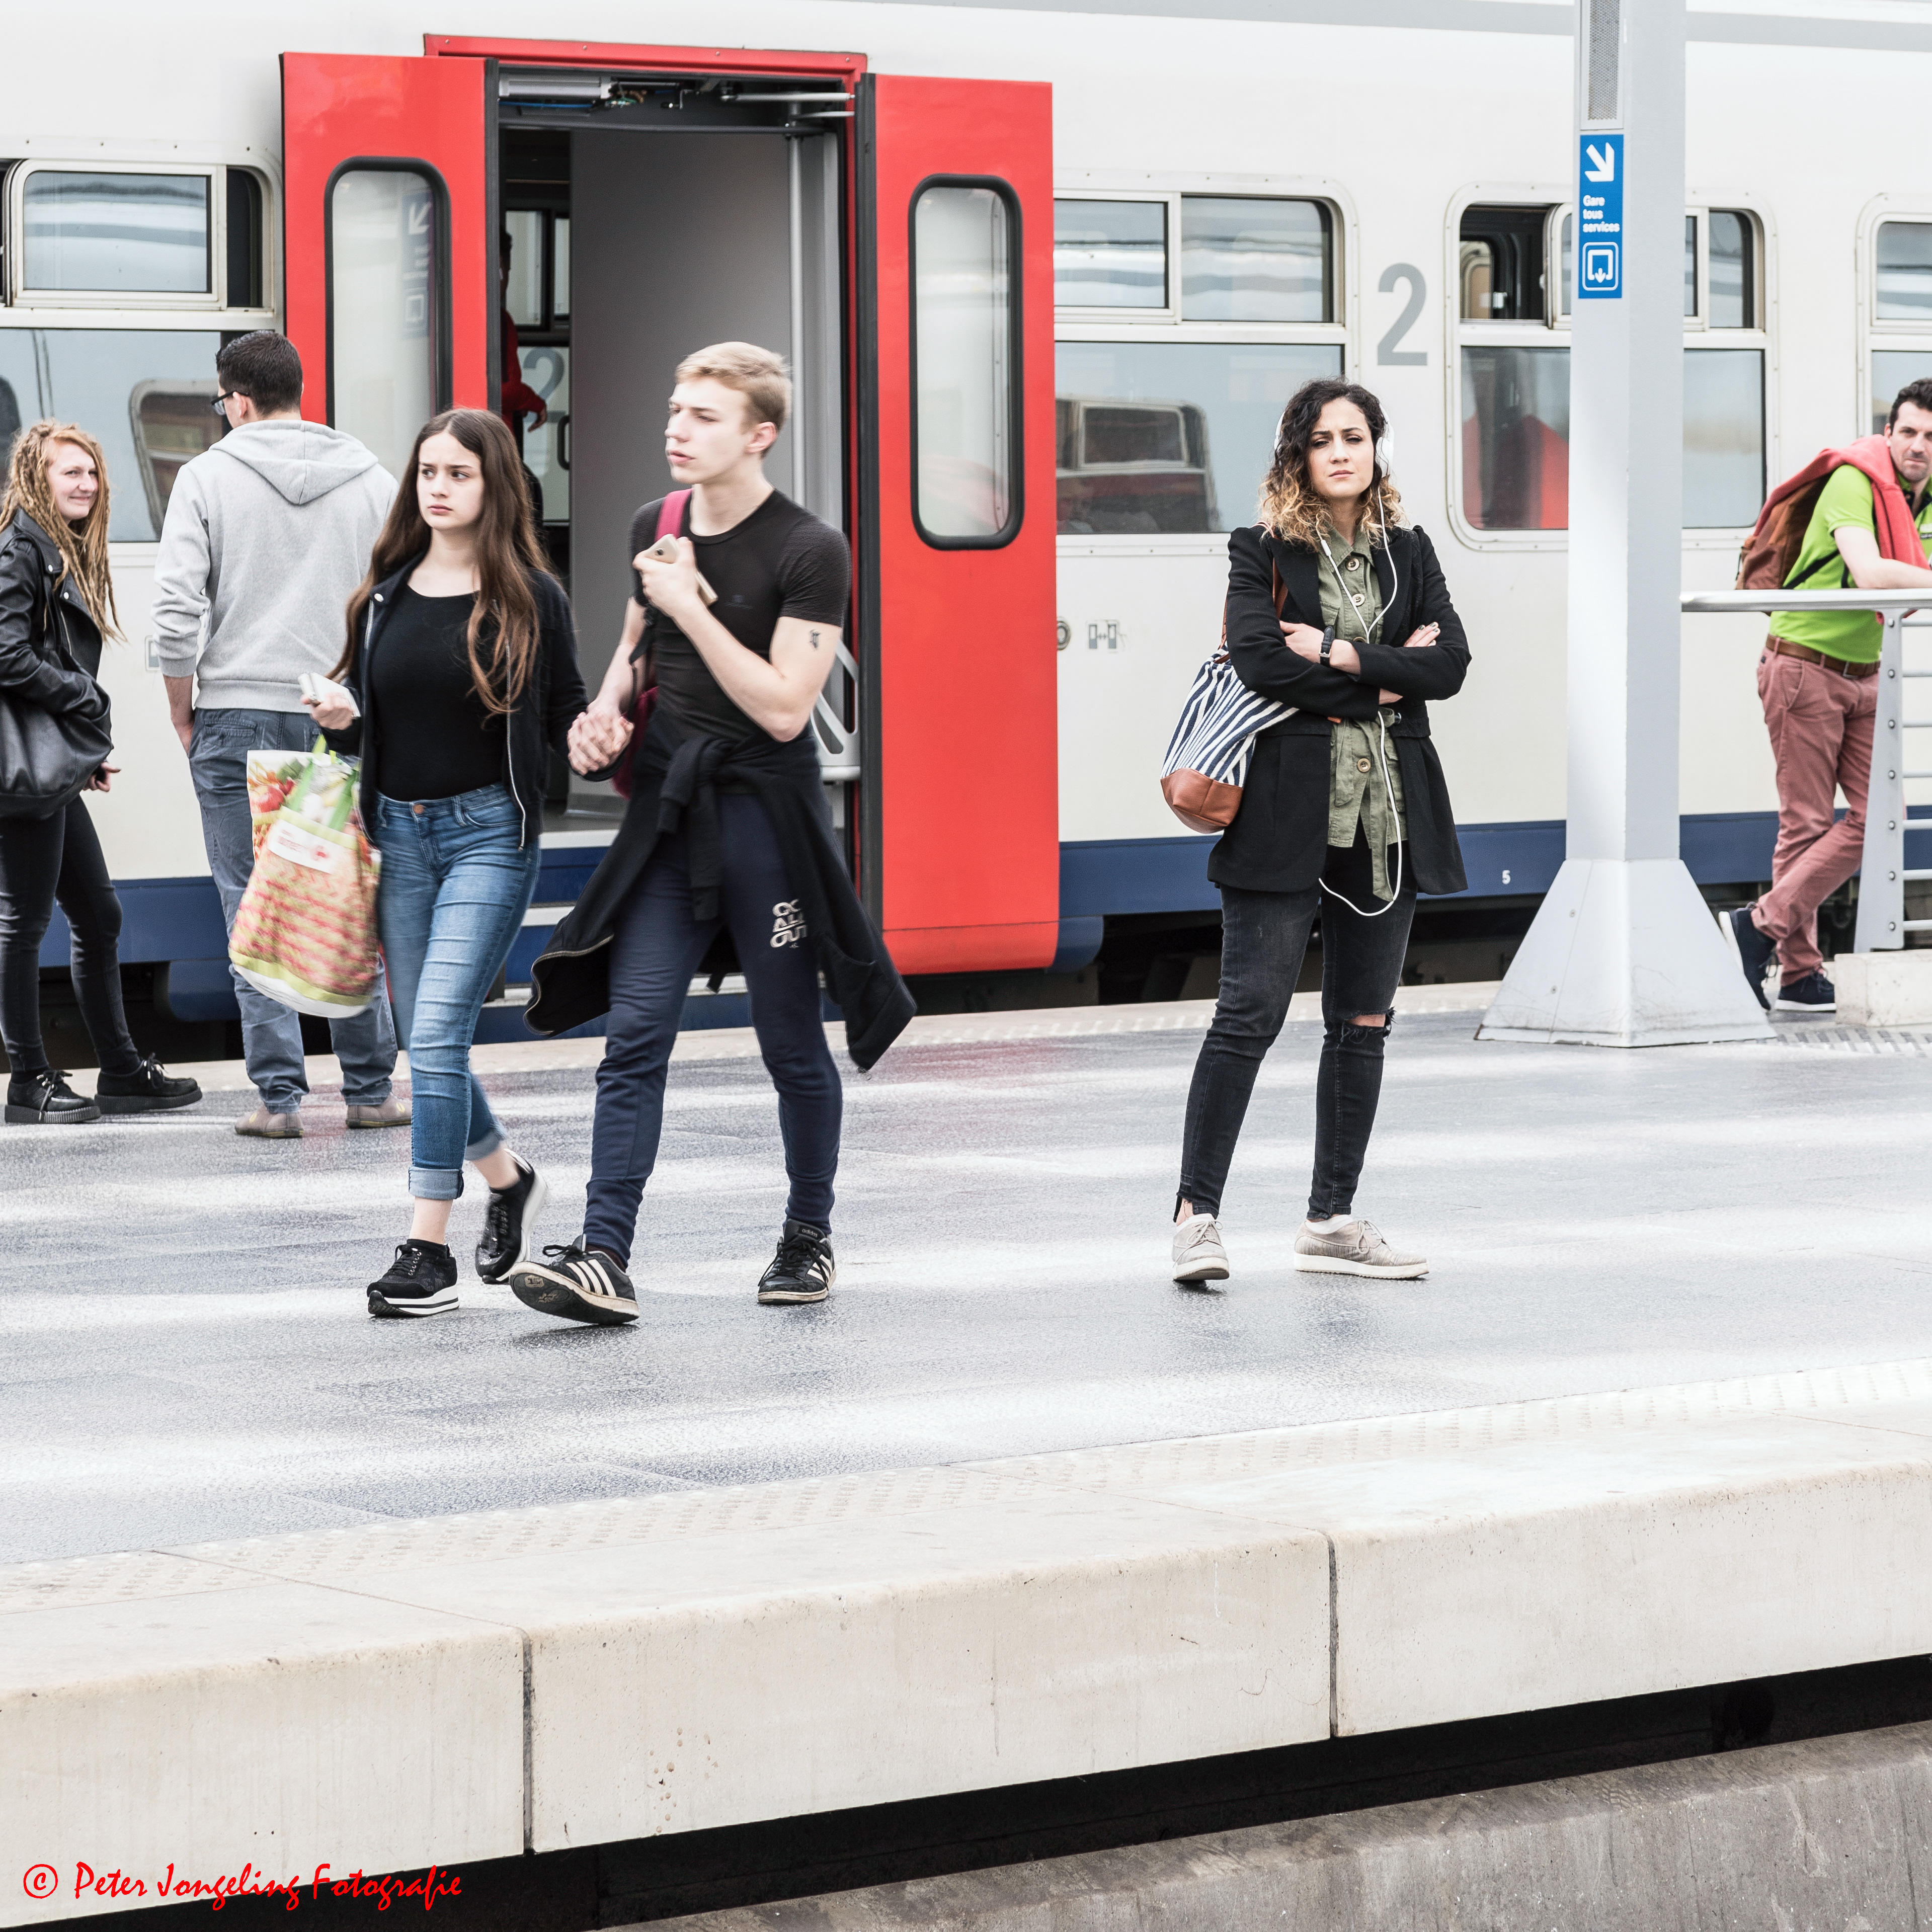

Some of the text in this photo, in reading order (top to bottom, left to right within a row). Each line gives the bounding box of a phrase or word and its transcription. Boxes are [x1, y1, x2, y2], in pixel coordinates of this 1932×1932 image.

[1583, 195, 1605, 207] Gare
[1583, 209, 1603, 220] tous
[1583, 221, 1620, 233] services
[1378, 263, 1427, 366] 2
[1502, 870, 1511, 884] 5
